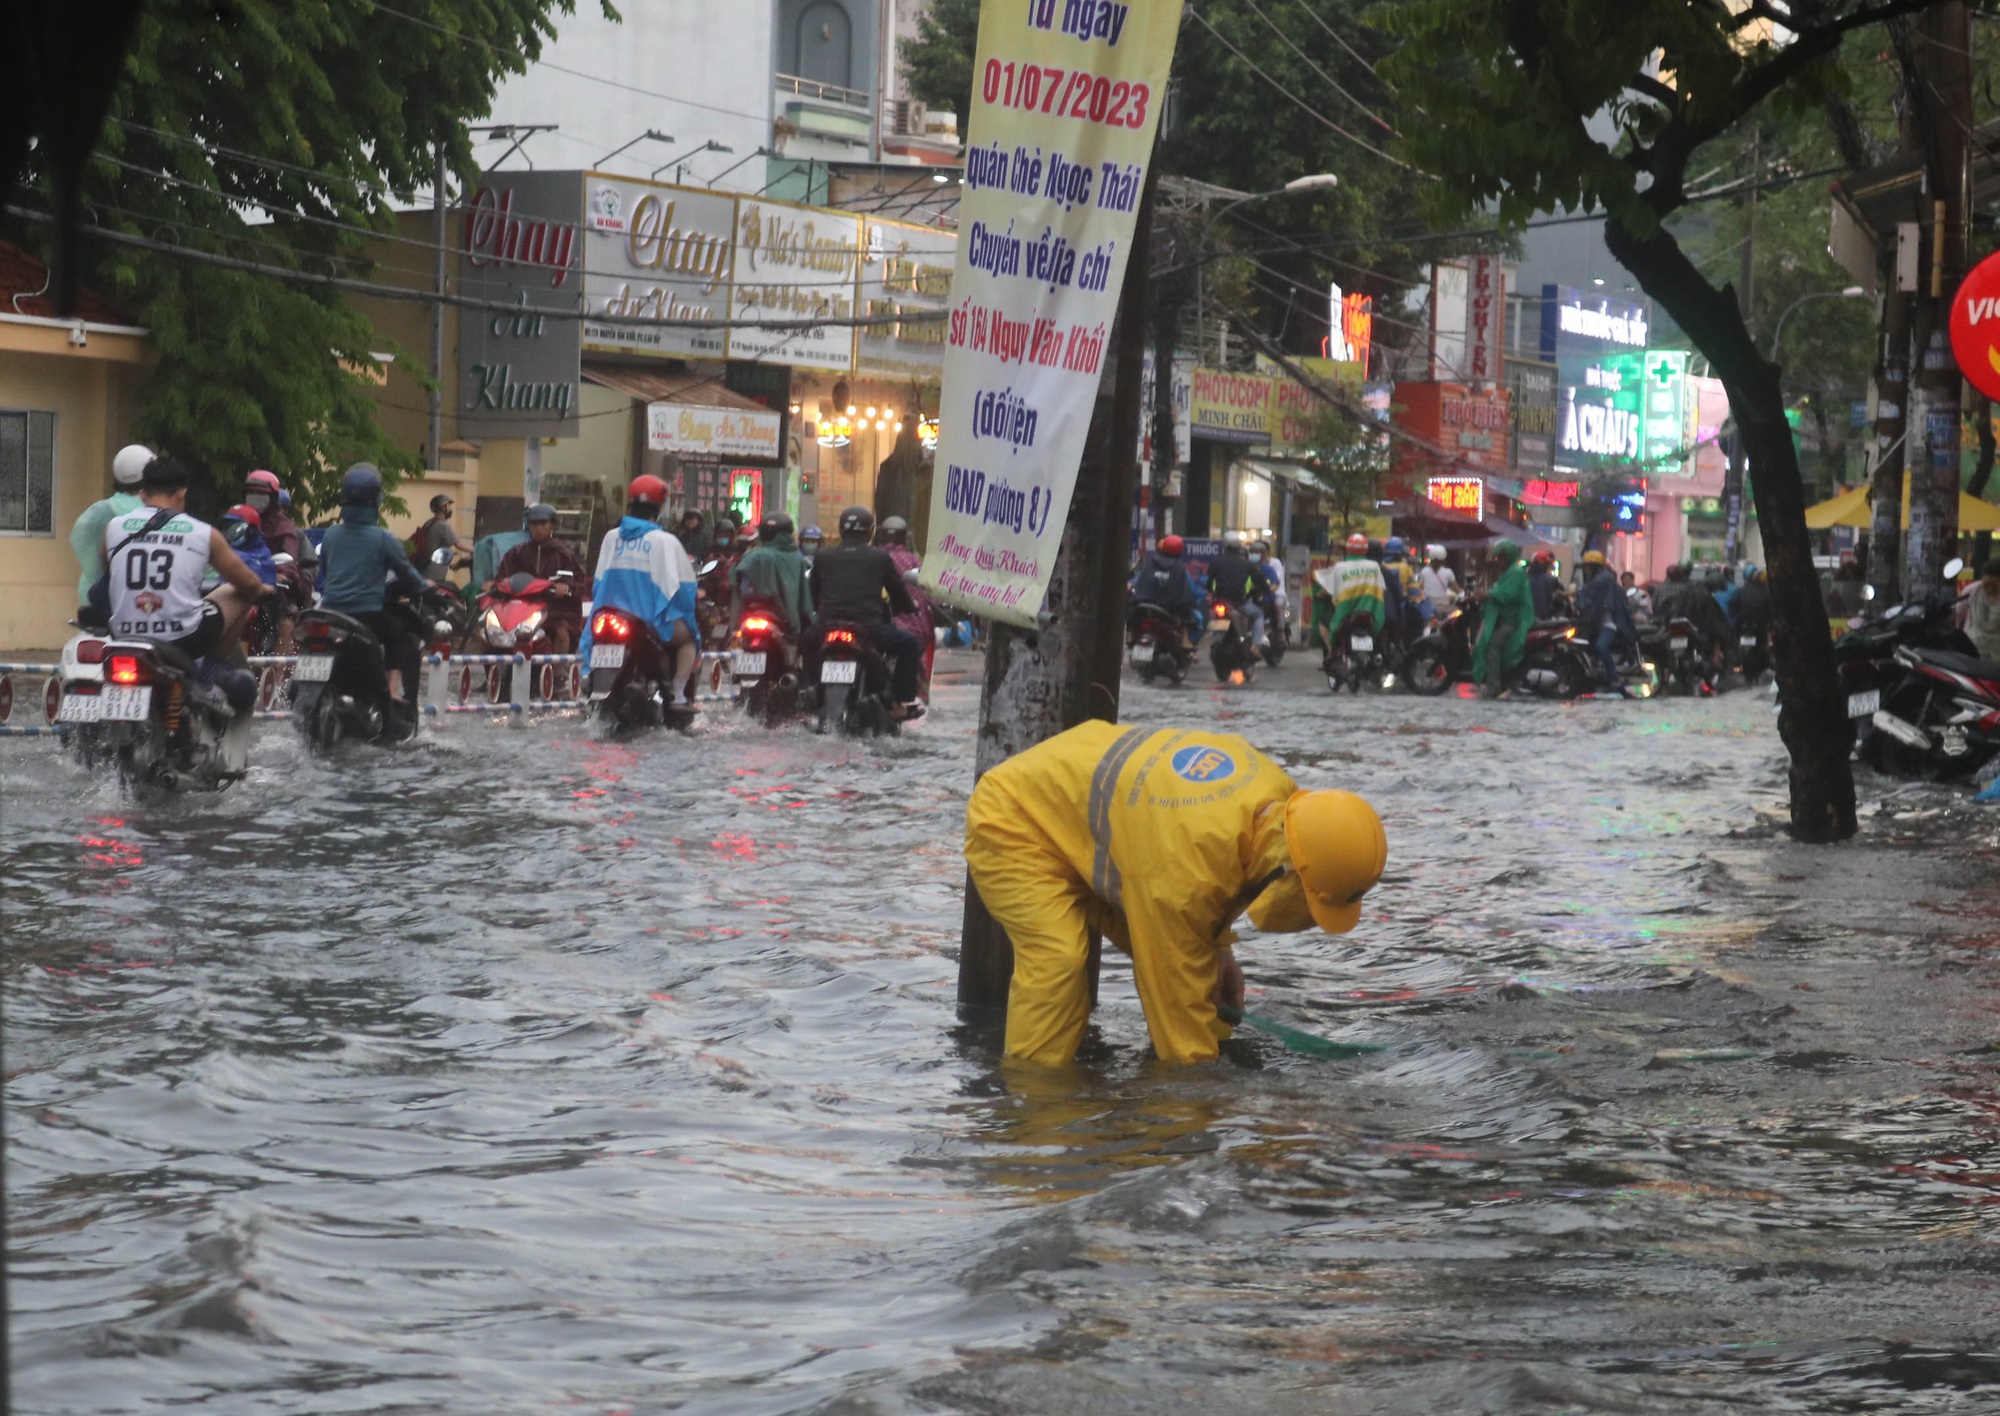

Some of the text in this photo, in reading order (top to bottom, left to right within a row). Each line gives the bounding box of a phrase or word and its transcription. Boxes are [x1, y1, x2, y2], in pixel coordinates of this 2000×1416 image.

[983, 58, 1150, 129] 01/07/2023
[967, 141, 1142, 213] quán Chè Ngọc Thái
[464, 186, 577, 289] Chay
[628, 194, 729, 296] Chay
[1079, 241, 1114, 292] chỉ
[950, 296, 971, 347] số
[1029, 317, 1064, 367] Văn
[1062, 322, 1105, 374] Khối
[465, 364, 575, 420] Khang
[1193, 371, 1272, 409] PHOTOCOPY
[1199, 408, 1229, 427] MINH
[126, 549, 174, 590] 03
[997, 549, 1039, 578] Khách
